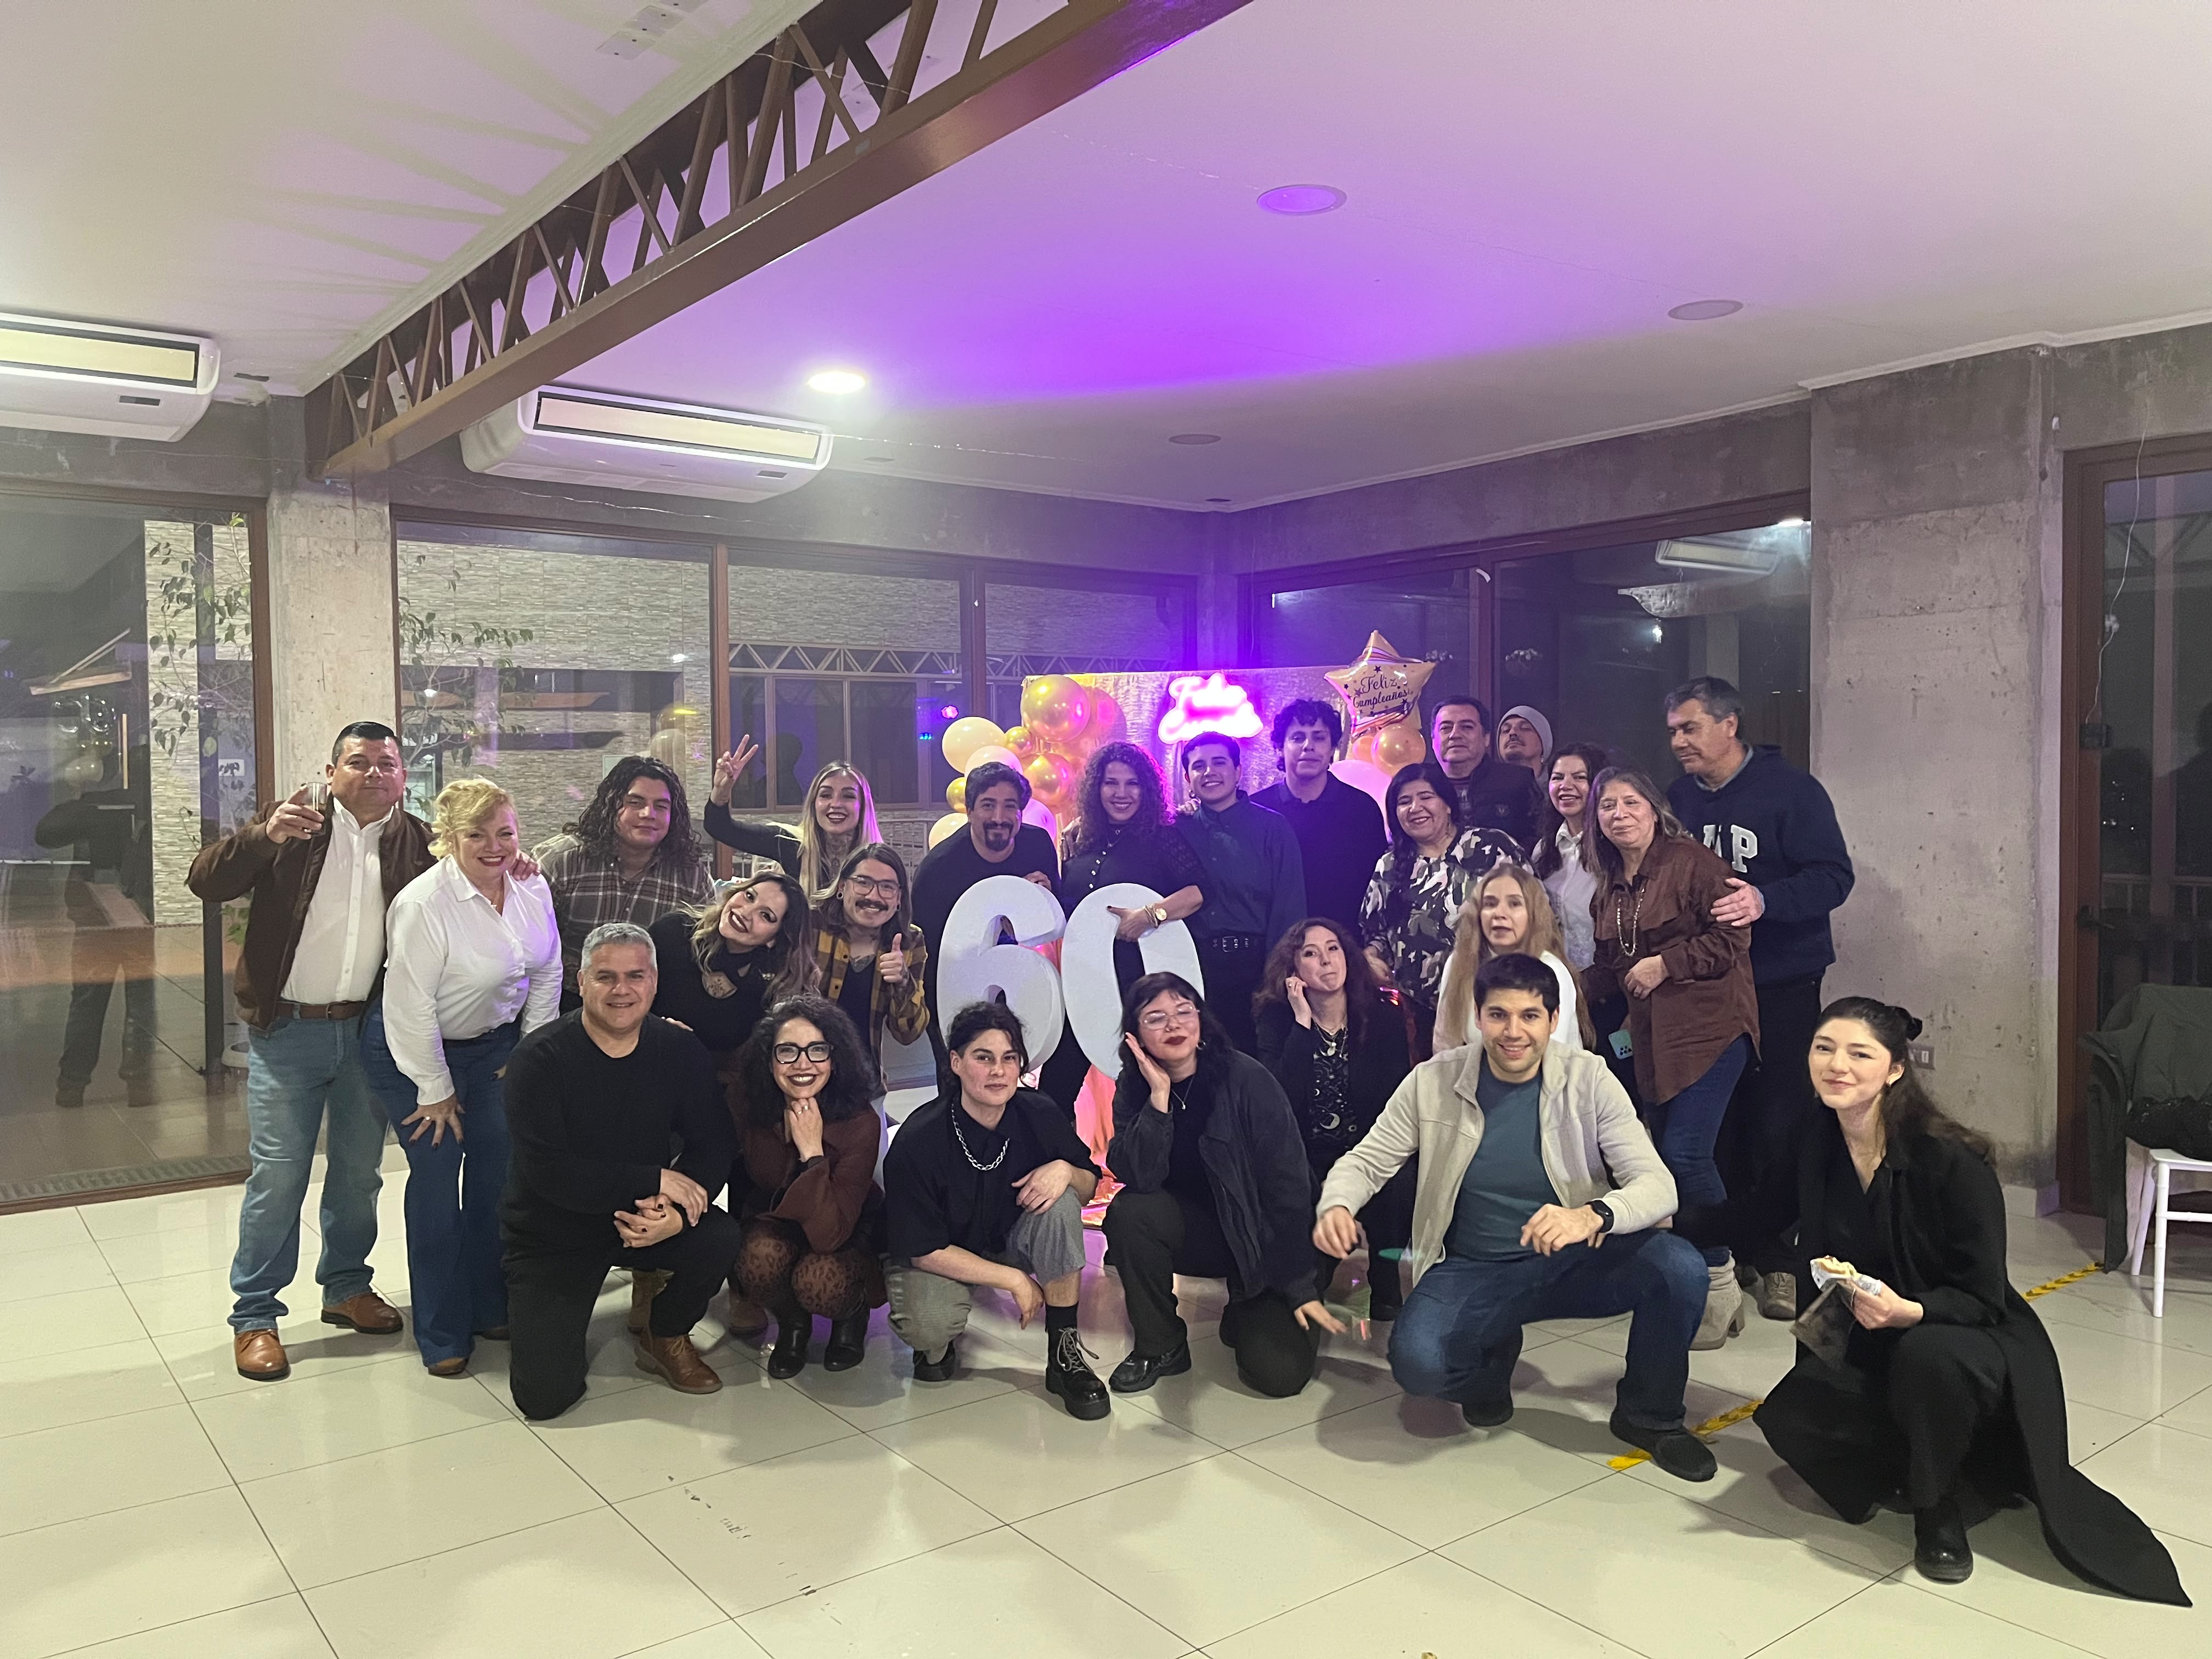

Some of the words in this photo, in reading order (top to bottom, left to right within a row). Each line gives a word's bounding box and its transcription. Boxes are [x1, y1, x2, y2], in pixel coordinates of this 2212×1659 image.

[1361, 674, 1397, 693] Feliz
[1353, 689, 1407, 710] Cumpleaños
[936, 874, 1205, 1080] 60
